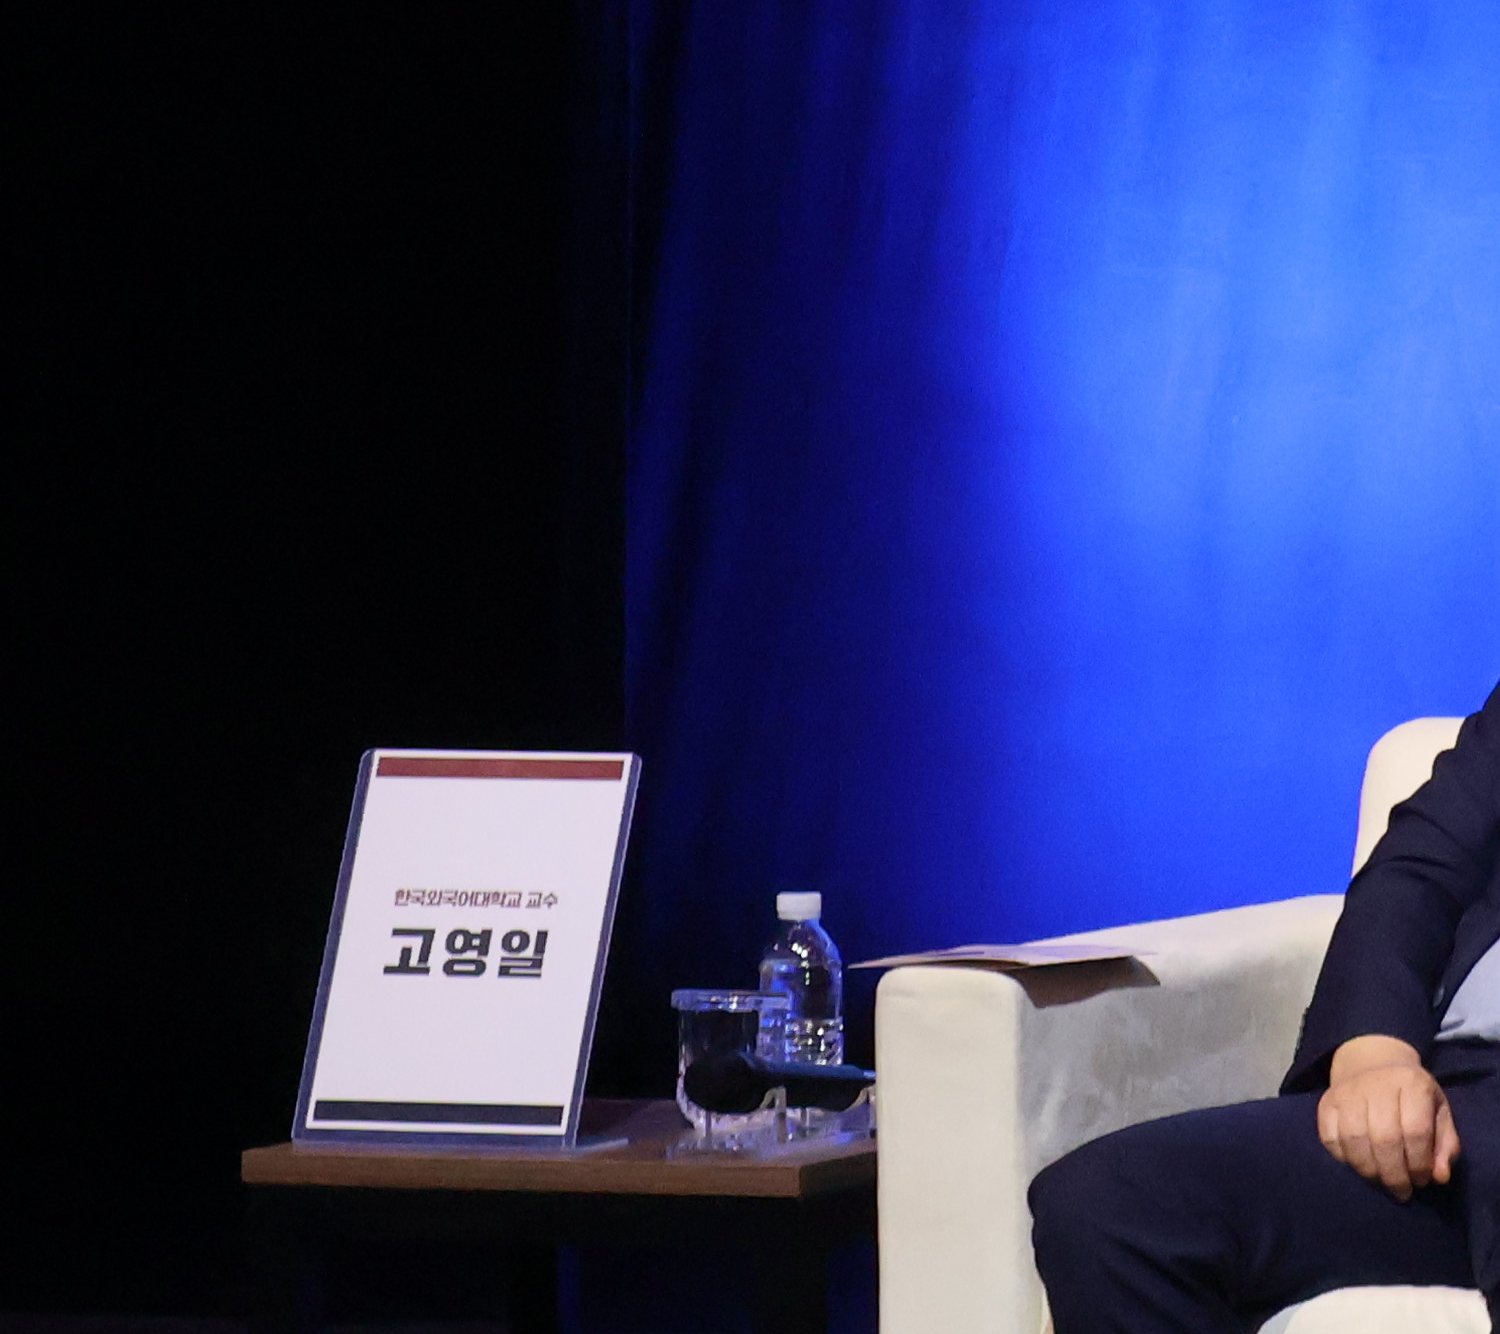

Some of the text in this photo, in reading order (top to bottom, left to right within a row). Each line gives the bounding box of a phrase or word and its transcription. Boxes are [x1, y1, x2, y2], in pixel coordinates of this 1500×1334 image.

[394, 889, 559, 910] 한국외국어대학교 교수
[382, 927, 550, 980] 고영일
